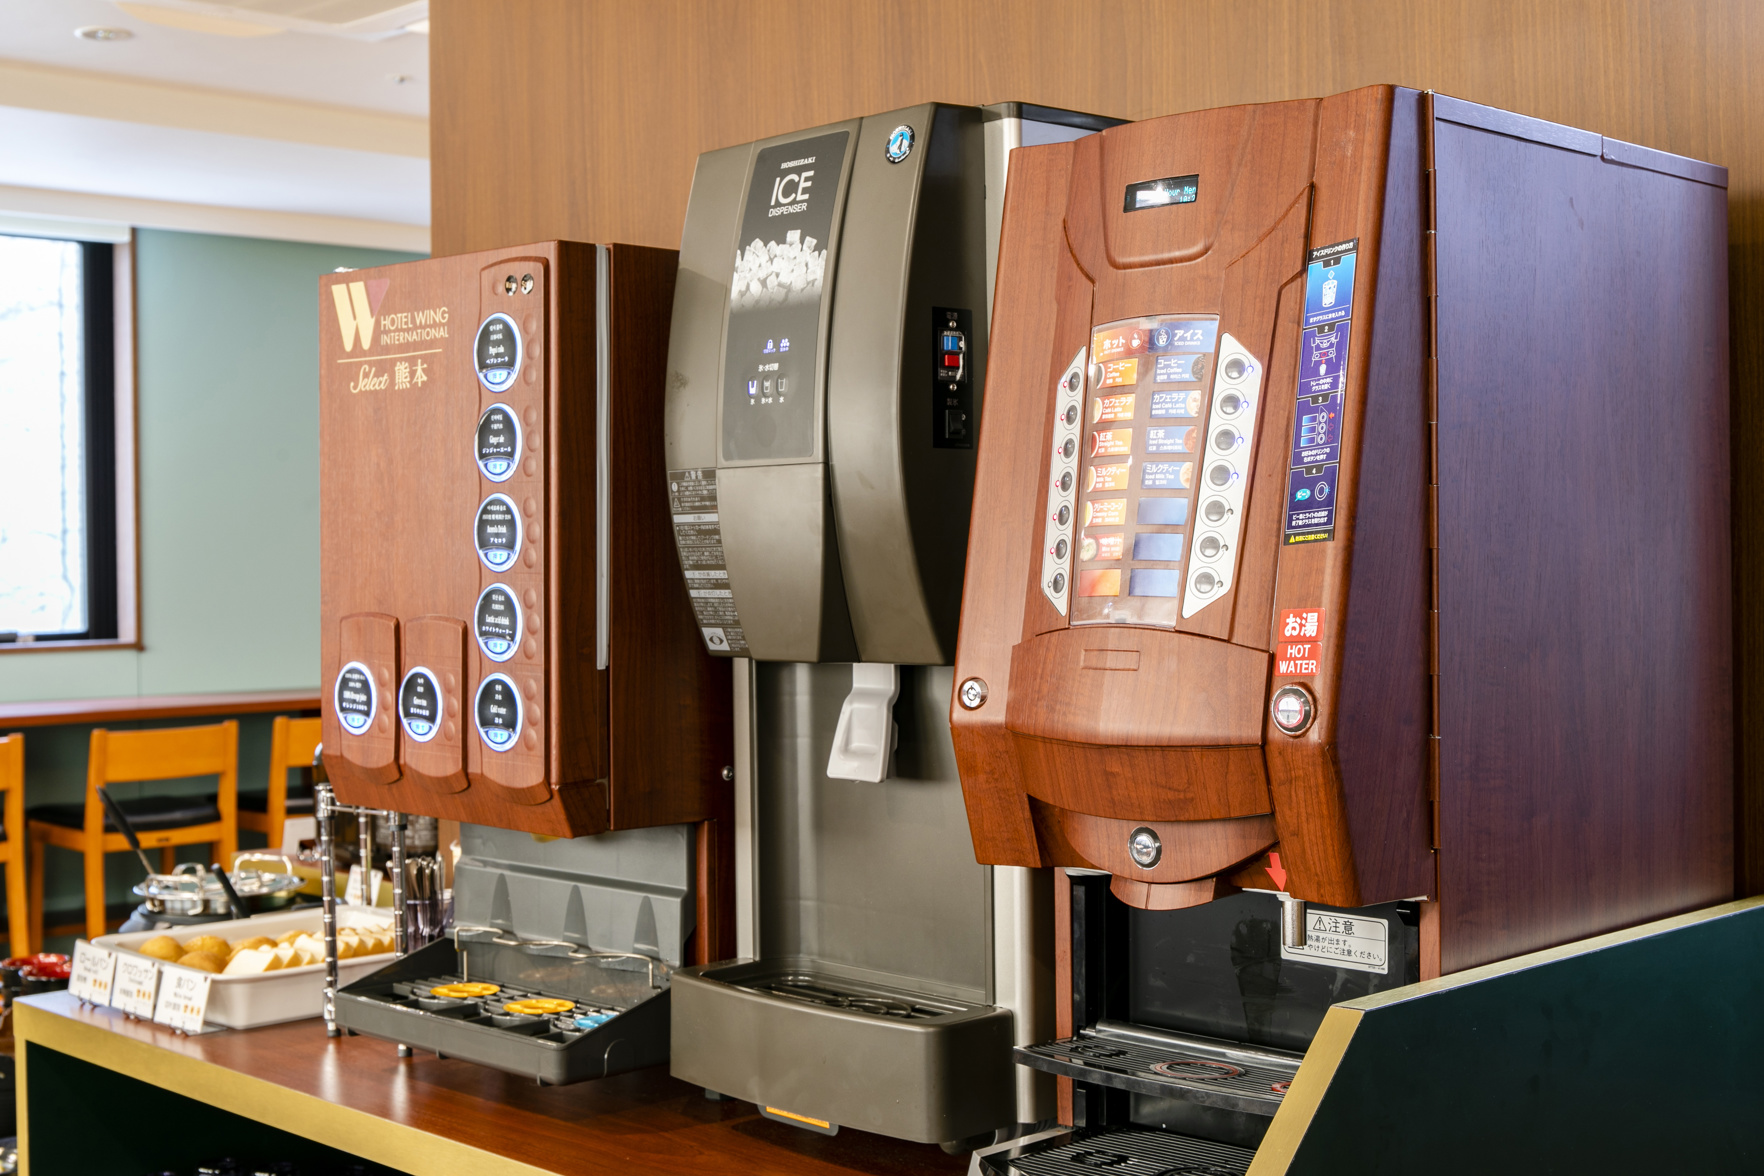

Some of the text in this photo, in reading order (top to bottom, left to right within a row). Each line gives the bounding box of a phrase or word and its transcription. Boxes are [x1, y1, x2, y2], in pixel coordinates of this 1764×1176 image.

[781, 156, 816, 169] HOSHIZAKI
[771, 171, 814, 205] ICE
[769, 203, 807, 217] DISPENSER
[380, 307, 449, 331] HOTEL WING
[381, 325, 449, 346] INTERNATIONAL
[1174, 329, 1203, 340] アイス
[1103, 336, 1125, 350] ホット
[1107, 362, 1132, 371] コーヒー
[1157, 359, 1185, 367] コーヒー
[351, 365, 389, 394] Select
[395, 359, 428, 390] 熊本
[1104, 397, 1133, 407] カフェラテ
[1153, 393, 1186, 402] カフェラテ
[1150, 430, 1165, 438] 紅茶
[1097, 467, 1126, 476] ミルクティー
[1146, 464, 1180, 473] ミルクティー
[1284, 612, 1318, 637] お湯
[1287, 645, 1311, 657] HOT
[1279, 660, 1316, 673] WATER
[1328, 918, 1355, 935] 注意
[1307, 934, 1351, 948] 熱湯が出ます。
[1308, 944, 1382, 961] やけどにご注意ください。
[79, 952, 109, 970] ロールパン
[122, 962, 154, 980] クロワッサン
[176, 976, 196, 991] 食パン
